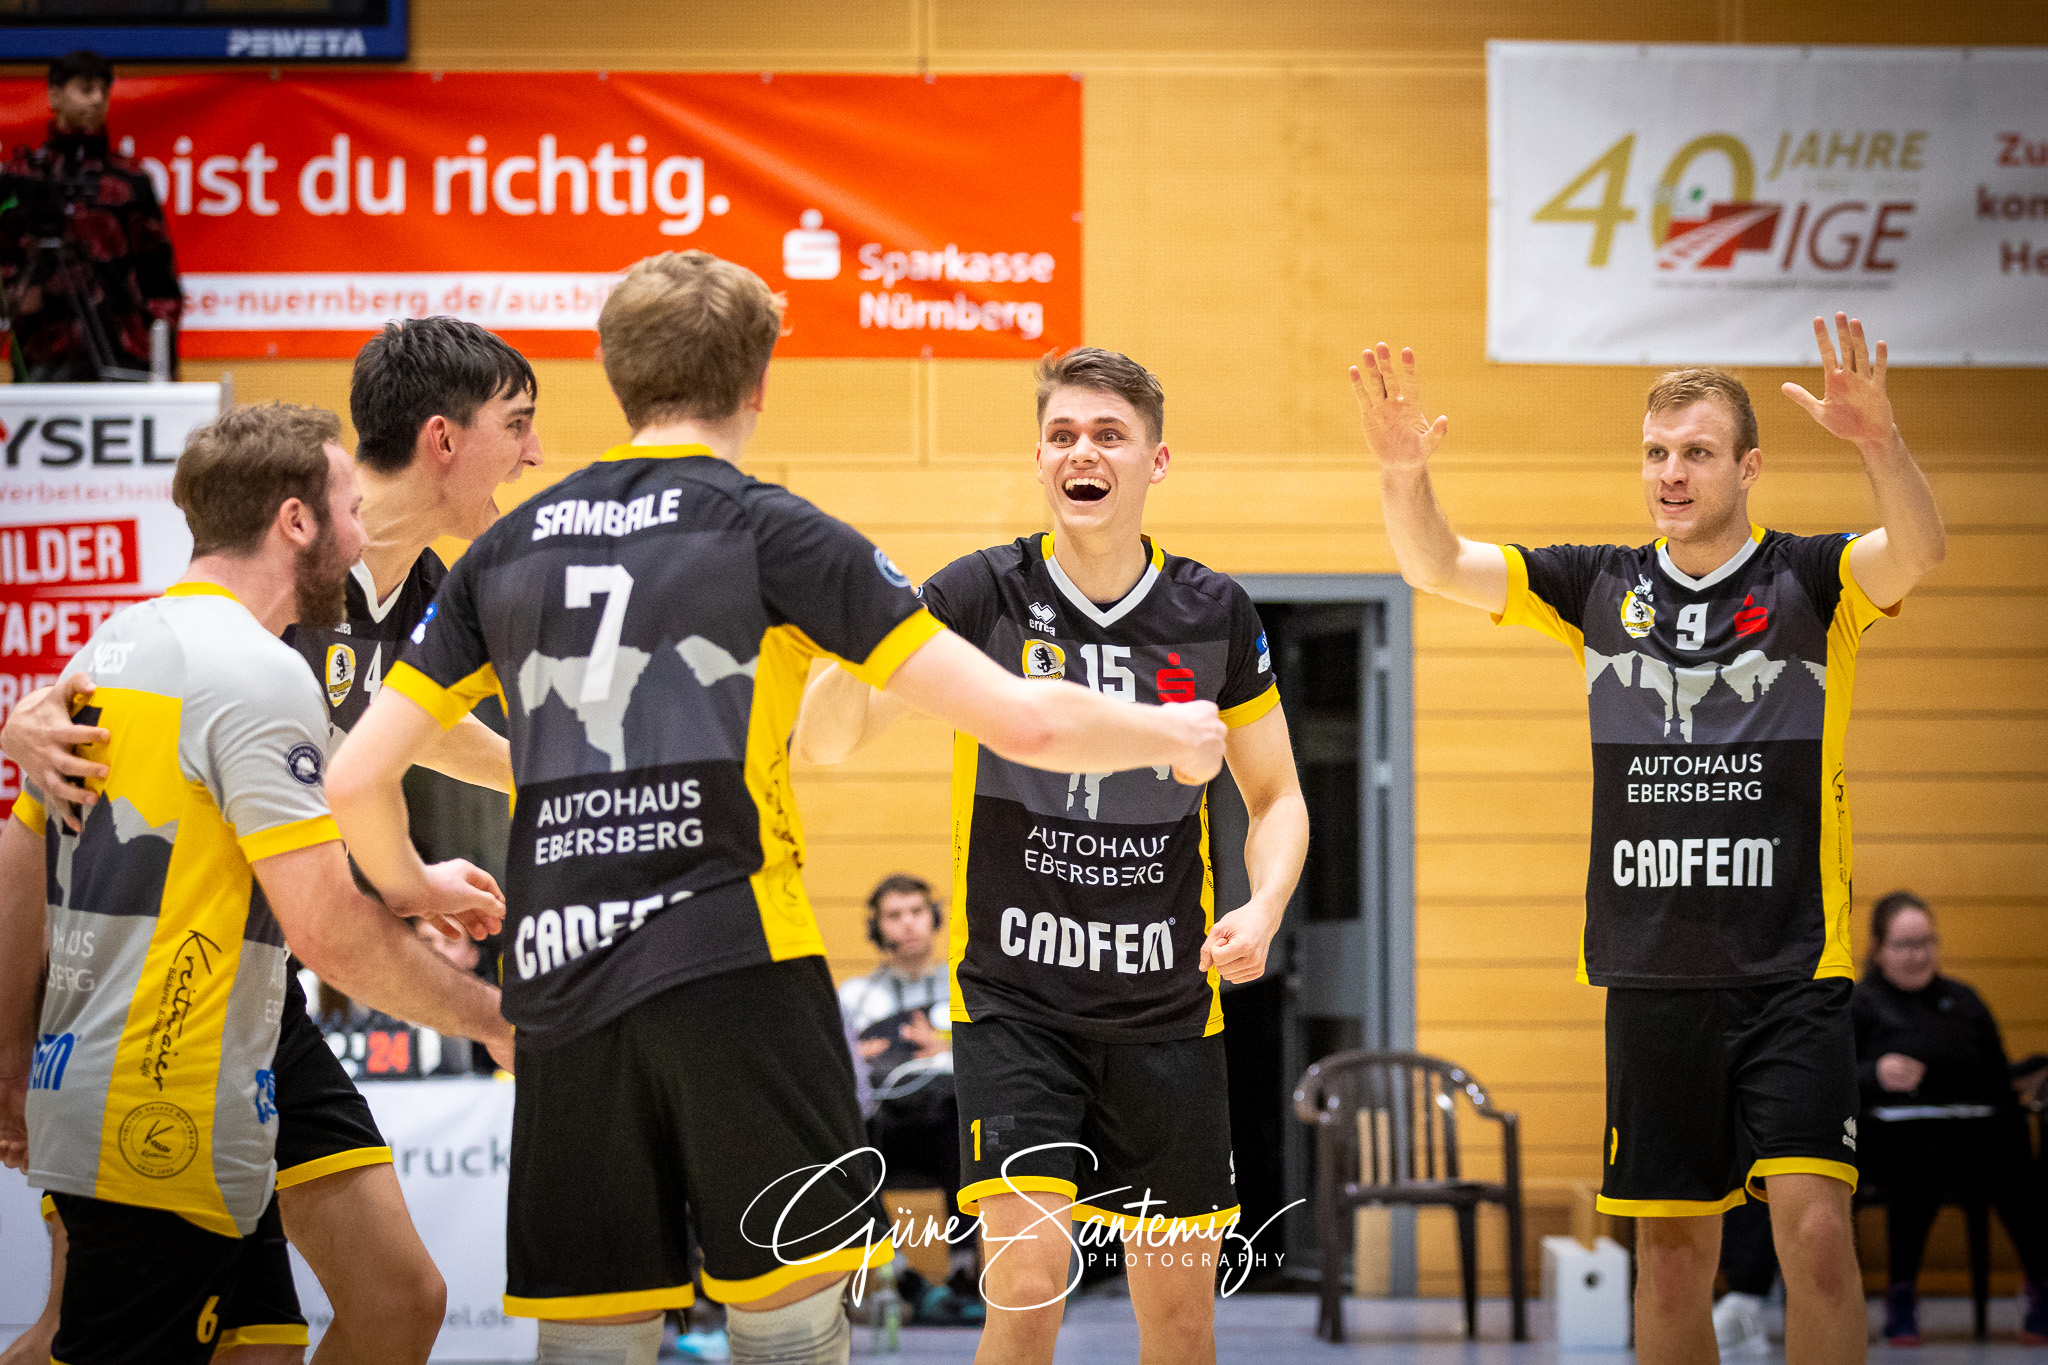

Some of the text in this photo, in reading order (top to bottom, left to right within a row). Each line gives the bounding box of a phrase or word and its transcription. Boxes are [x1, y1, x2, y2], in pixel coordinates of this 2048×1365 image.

[1765, 130, 1928, 181] JAHRE
[298, 132, 407, 217] du
[431, 133, 731, 236] richtig.
[1780, 201, 1916, 272] IGE
[858, 243, 1056, 289] Sparkasse
[859, 290, 1044, 339] Nürnberg
[532, 488, 682, 541] SAMBALE
[565, 564, 634, 703] 7
[1676, 602, 1709, 650] 9
[364, 641, 383, 706] 4
[1079, 643, 1136, 703] 15
[1628, 753, 1762, 776] AUTOHAUS
[537, 779, 701, 828] AUTOHAUS
[1627, 781, 1762, 803] EBERSBERG
[535, 819, 703, 865] EBERSBERG
[1027, 825, 1170, 858] AUTOHAUS
[1024, 850, 1164, 887] EBERSBERG
[196, 1295, 220, 1344] 6
